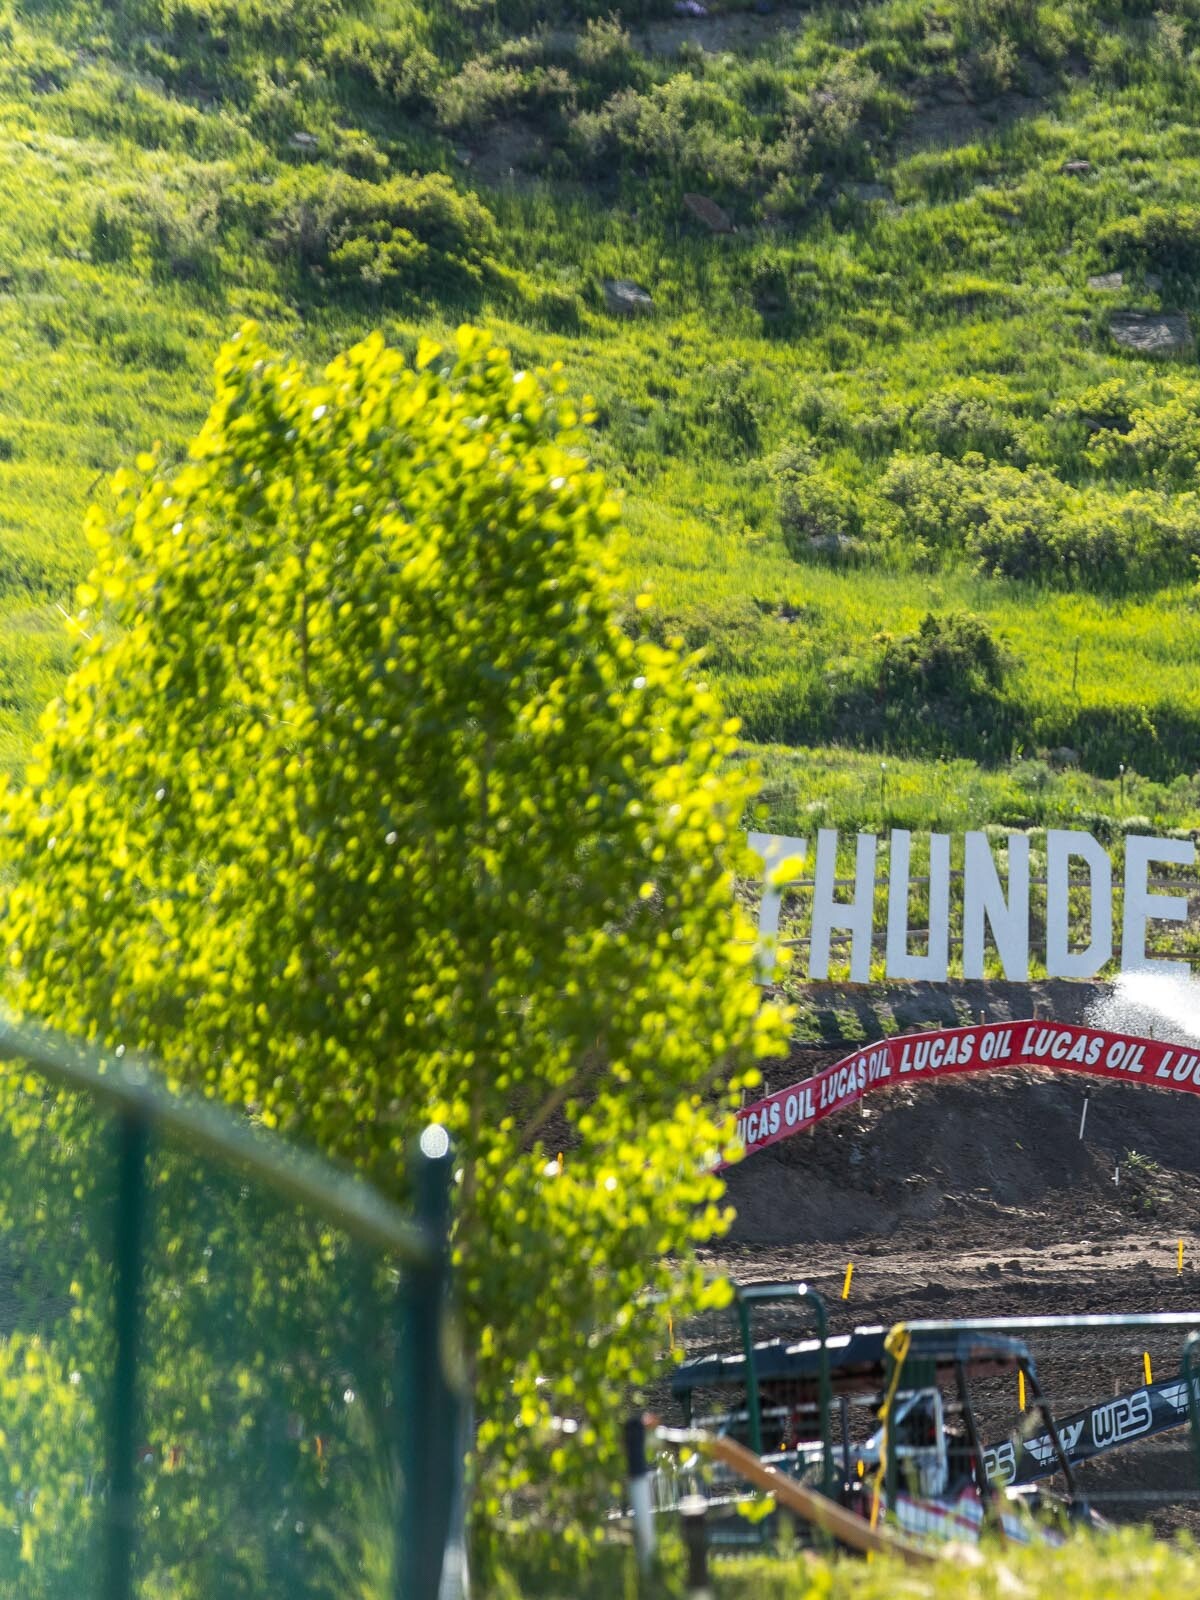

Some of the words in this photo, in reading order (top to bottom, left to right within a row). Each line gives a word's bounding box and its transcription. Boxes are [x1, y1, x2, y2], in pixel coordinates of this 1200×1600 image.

[820, 1056, 867, 1109] LUCAS
[869, 1048, 892, 1082] OIL
[899, 1034, 975, 1073] LUCAS
[980, 1030, 1012, 1061] OIL
[1021, 1027, 1104, 1065] LUCAS
[1106, 1041, 1146, 1072] OIL
[736, 1101, 781, 1145] UCAS
[784, 1087, 816, 1127] OIL
[1092, 1390, 1152, 1448] WPS
